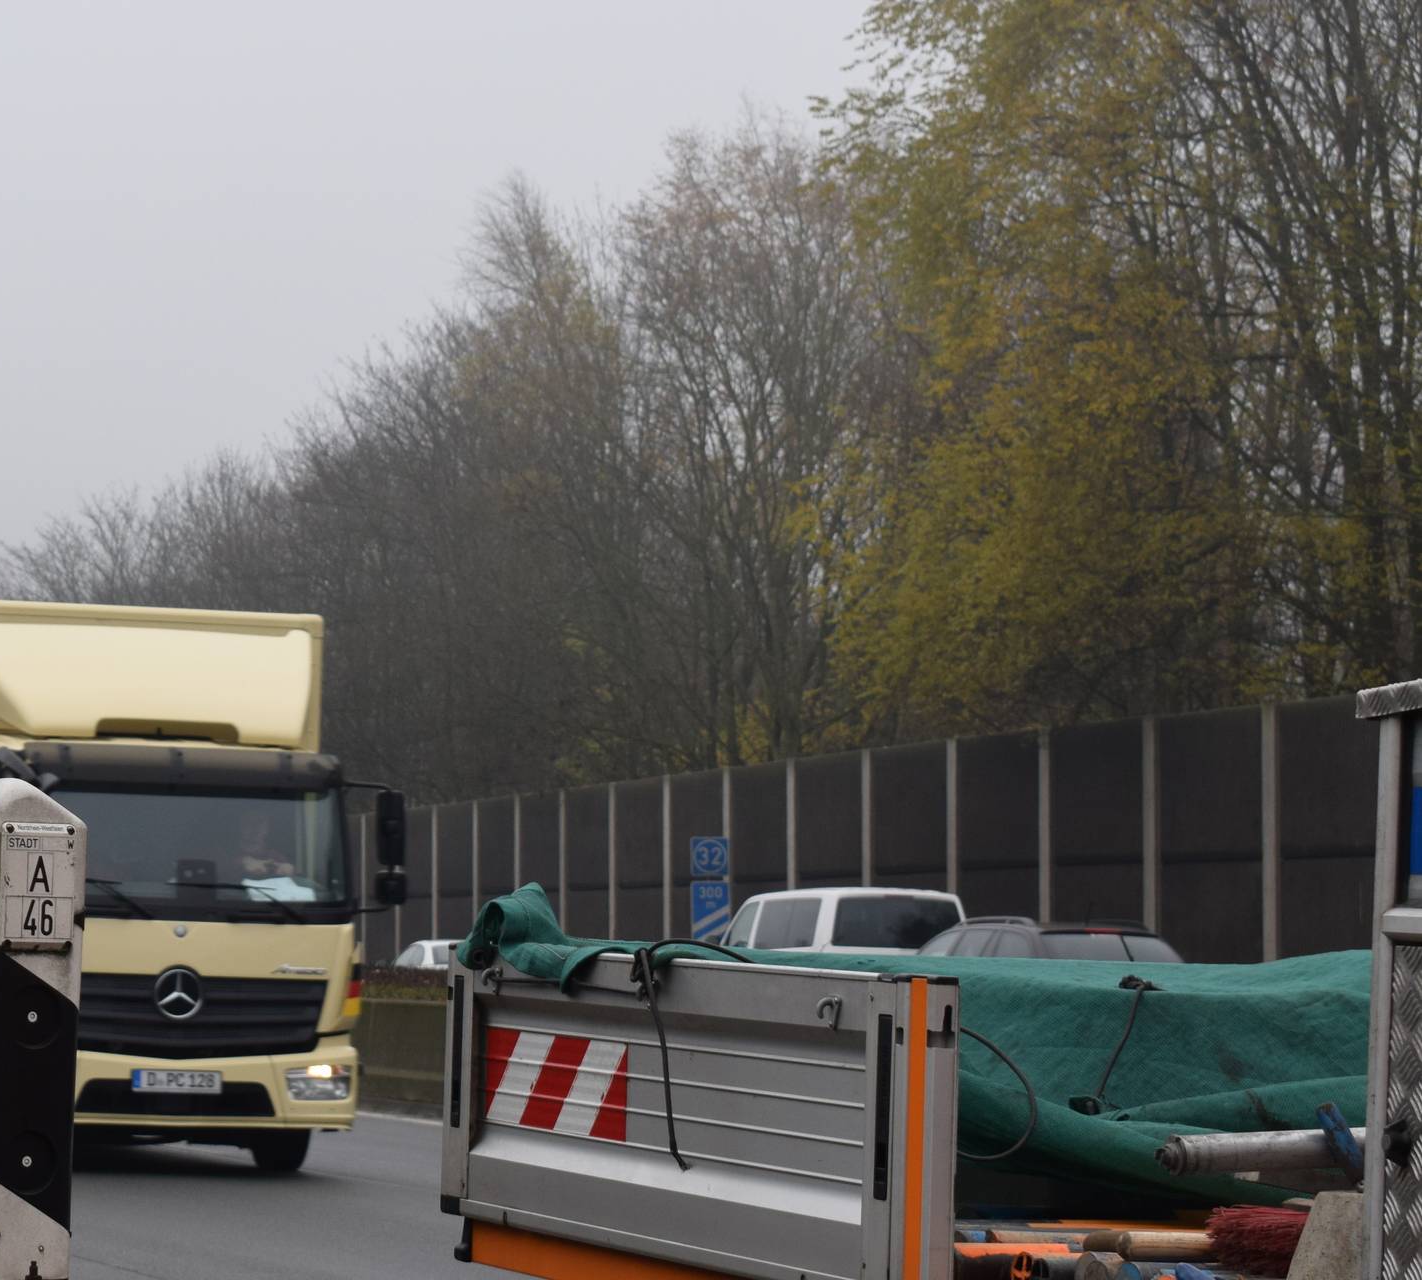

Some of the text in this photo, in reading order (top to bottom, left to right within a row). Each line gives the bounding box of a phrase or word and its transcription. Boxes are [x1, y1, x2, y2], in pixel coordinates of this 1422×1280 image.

[9, 837, 75, 849] STADT W
[697, 847, 722, 865] 32
[29, 856, 50, 892] A
[698, 886, 723, 898] 300
[23, 899, 54, 936] 46
[188, 1073, 215, 1088] 128
